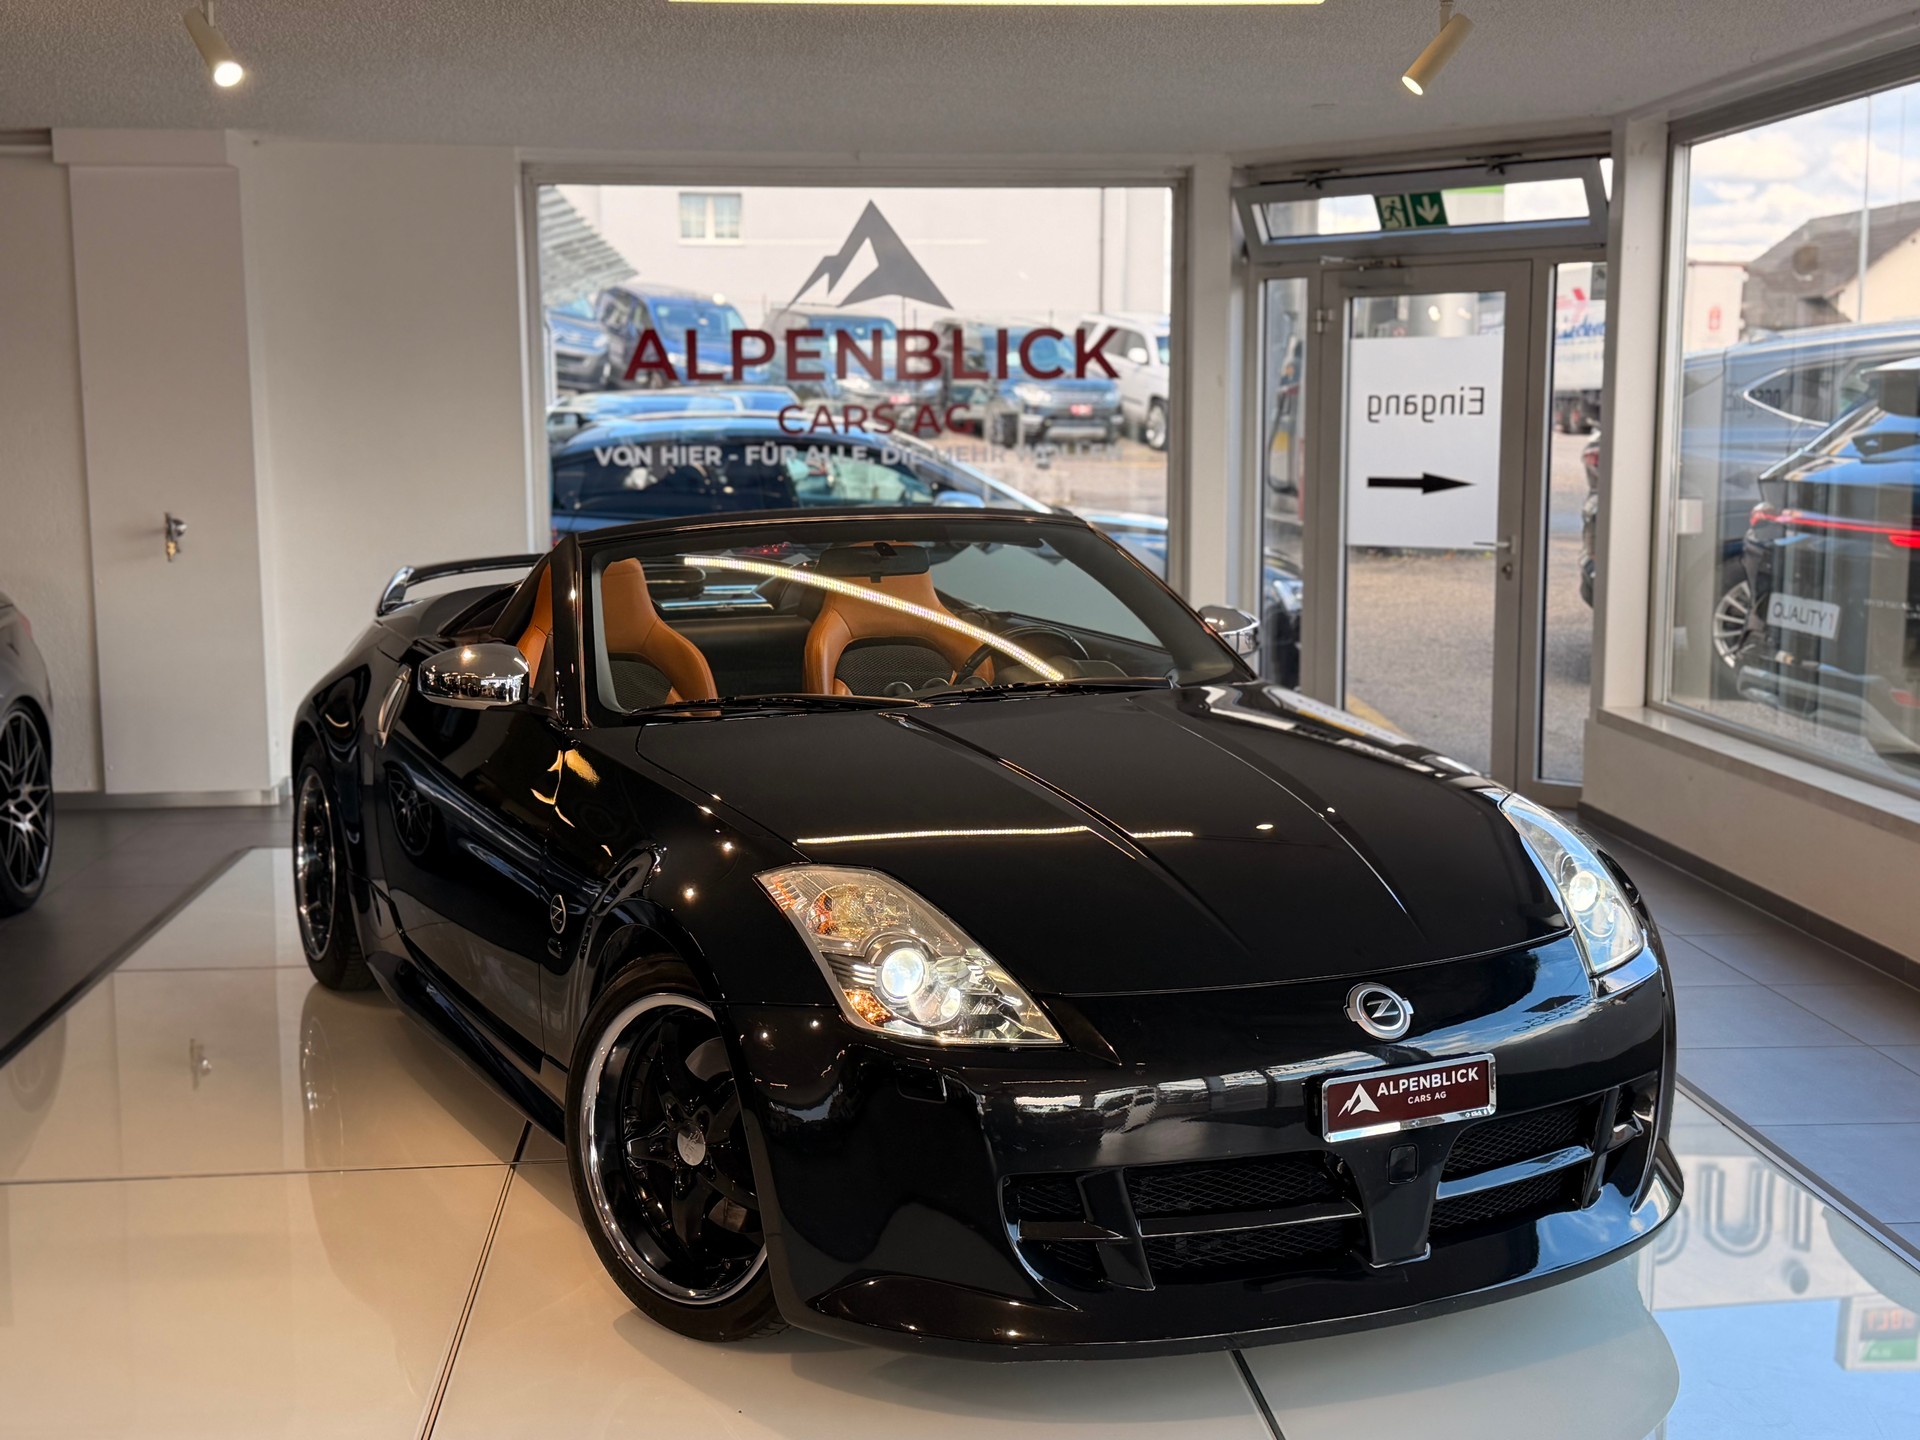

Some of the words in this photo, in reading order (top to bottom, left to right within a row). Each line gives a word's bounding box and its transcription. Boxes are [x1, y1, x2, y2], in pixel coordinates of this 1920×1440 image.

[623, 327, 1121, 381] ALPENBLICK
[777, 403, 896, 435] CARS
[912, 403, 975, 434] AG
[594, 446, 652, 467] VON
[660, 446, 722, 466] HIER
[745, 440, 798, 466] FÜR
[1376, 1066, 1480, 1098] ALPENBLICK
[1407, 1093, 1432, 1105] CARS
[1434, 1091, 1447, 1100] AG
